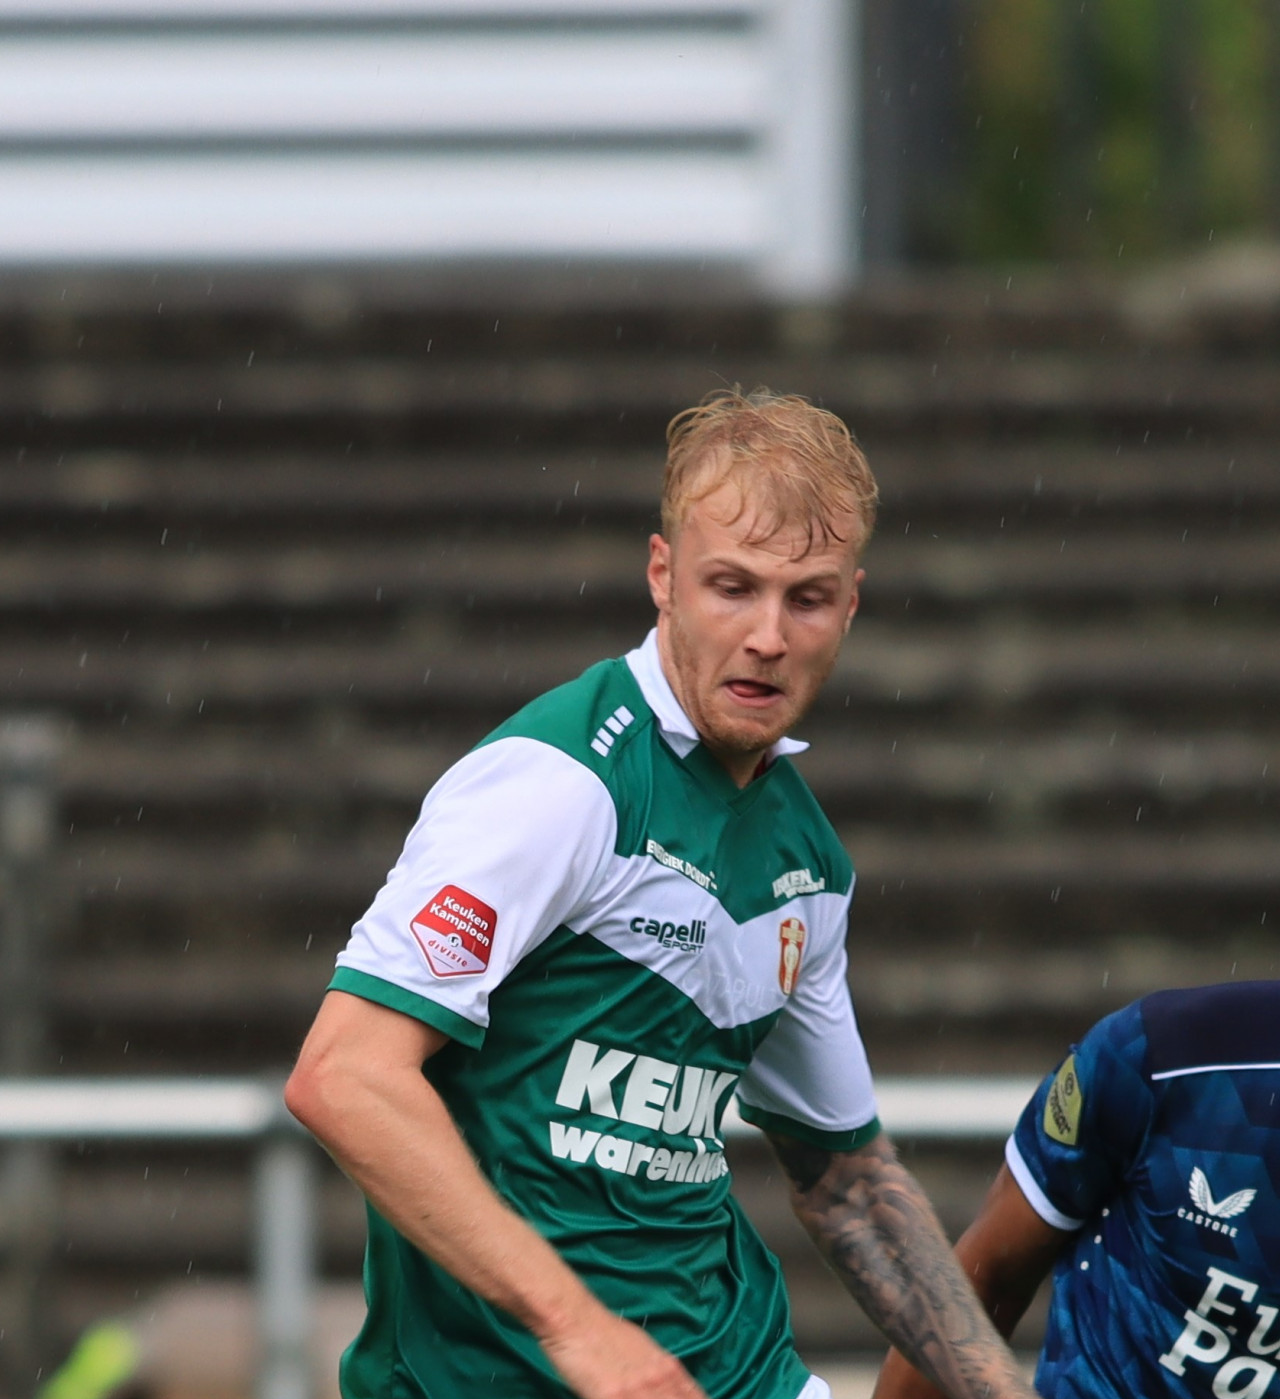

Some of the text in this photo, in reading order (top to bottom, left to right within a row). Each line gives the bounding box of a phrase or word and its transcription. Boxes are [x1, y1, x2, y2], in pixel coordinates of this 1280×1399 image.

[429, 903, 490, 947] Kampioen
[443, 896, 489, 931] Keuken
[629, 917, 706, 944] capelli
[428, 939, 468, 967] divisie
[662, 939, 704, 954] SPORT
[555, 1039, 738, 1139] KEUK
[1177, 1207, 1238, 1238] CASTORE
